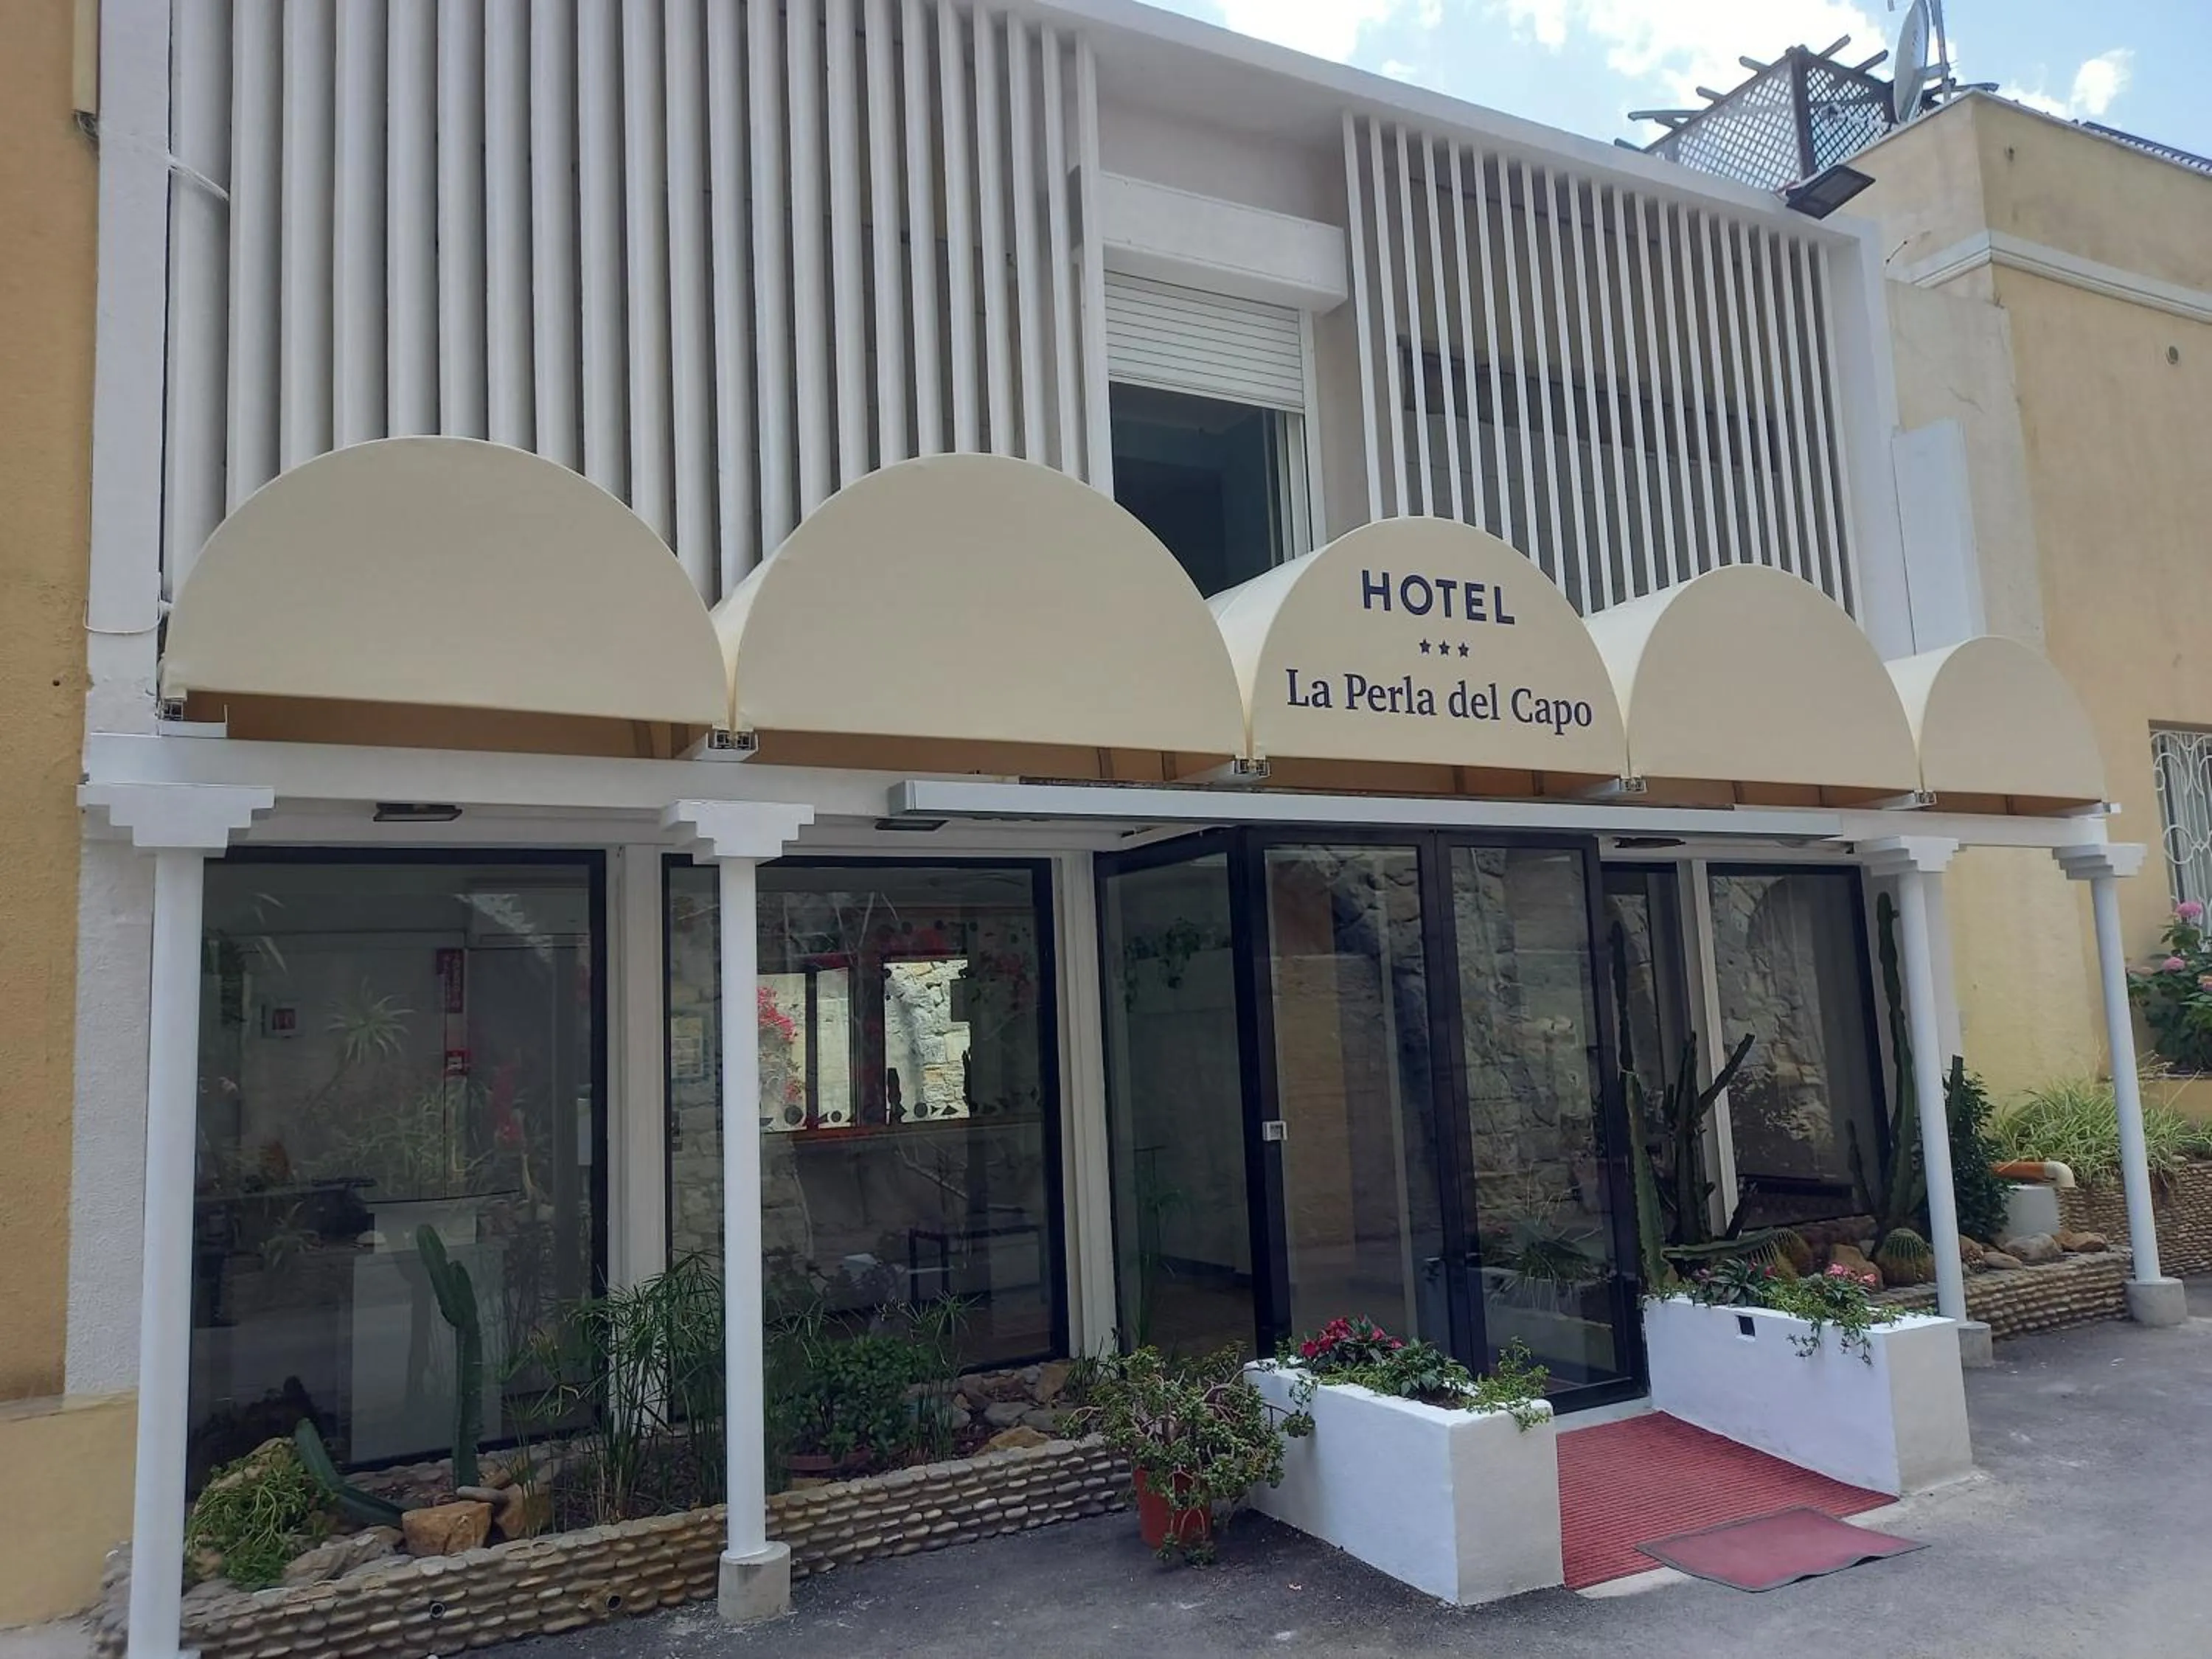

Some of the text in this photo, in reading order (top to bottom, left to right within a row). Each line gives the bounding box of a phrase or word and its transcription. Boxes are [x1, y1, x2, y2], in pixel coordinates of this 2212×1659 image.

[1362, 570, 1515, 625] HOTEL
[1286, 669, 1593, 735] La Perla del Capo
